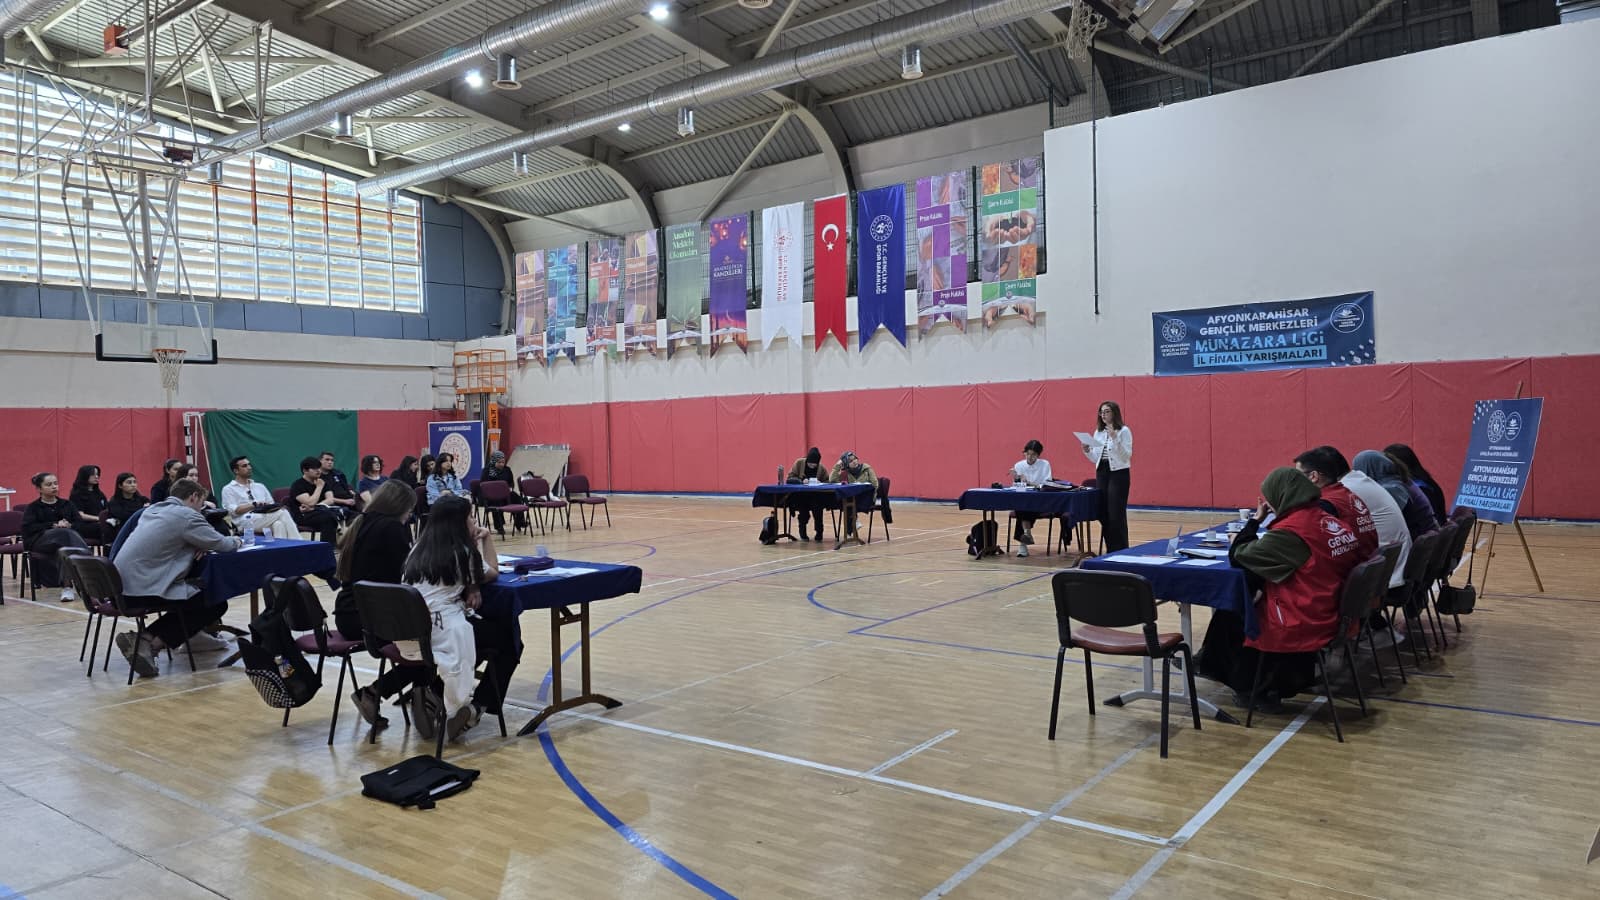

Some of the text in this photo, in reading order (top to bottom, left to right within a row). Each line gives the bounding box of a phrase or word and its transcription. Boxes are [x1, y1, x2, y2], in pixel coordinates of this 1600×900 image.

[1207, 307, 1309, 325] AFYONKARAHİSAR
[1200, 322, 1246, 337] GENÇLİK
[1249, 316, 1318, 332] MERKEZLERİ
[1197, 349, 1322, 365] İL FİNALİ YARIŞMALARI
